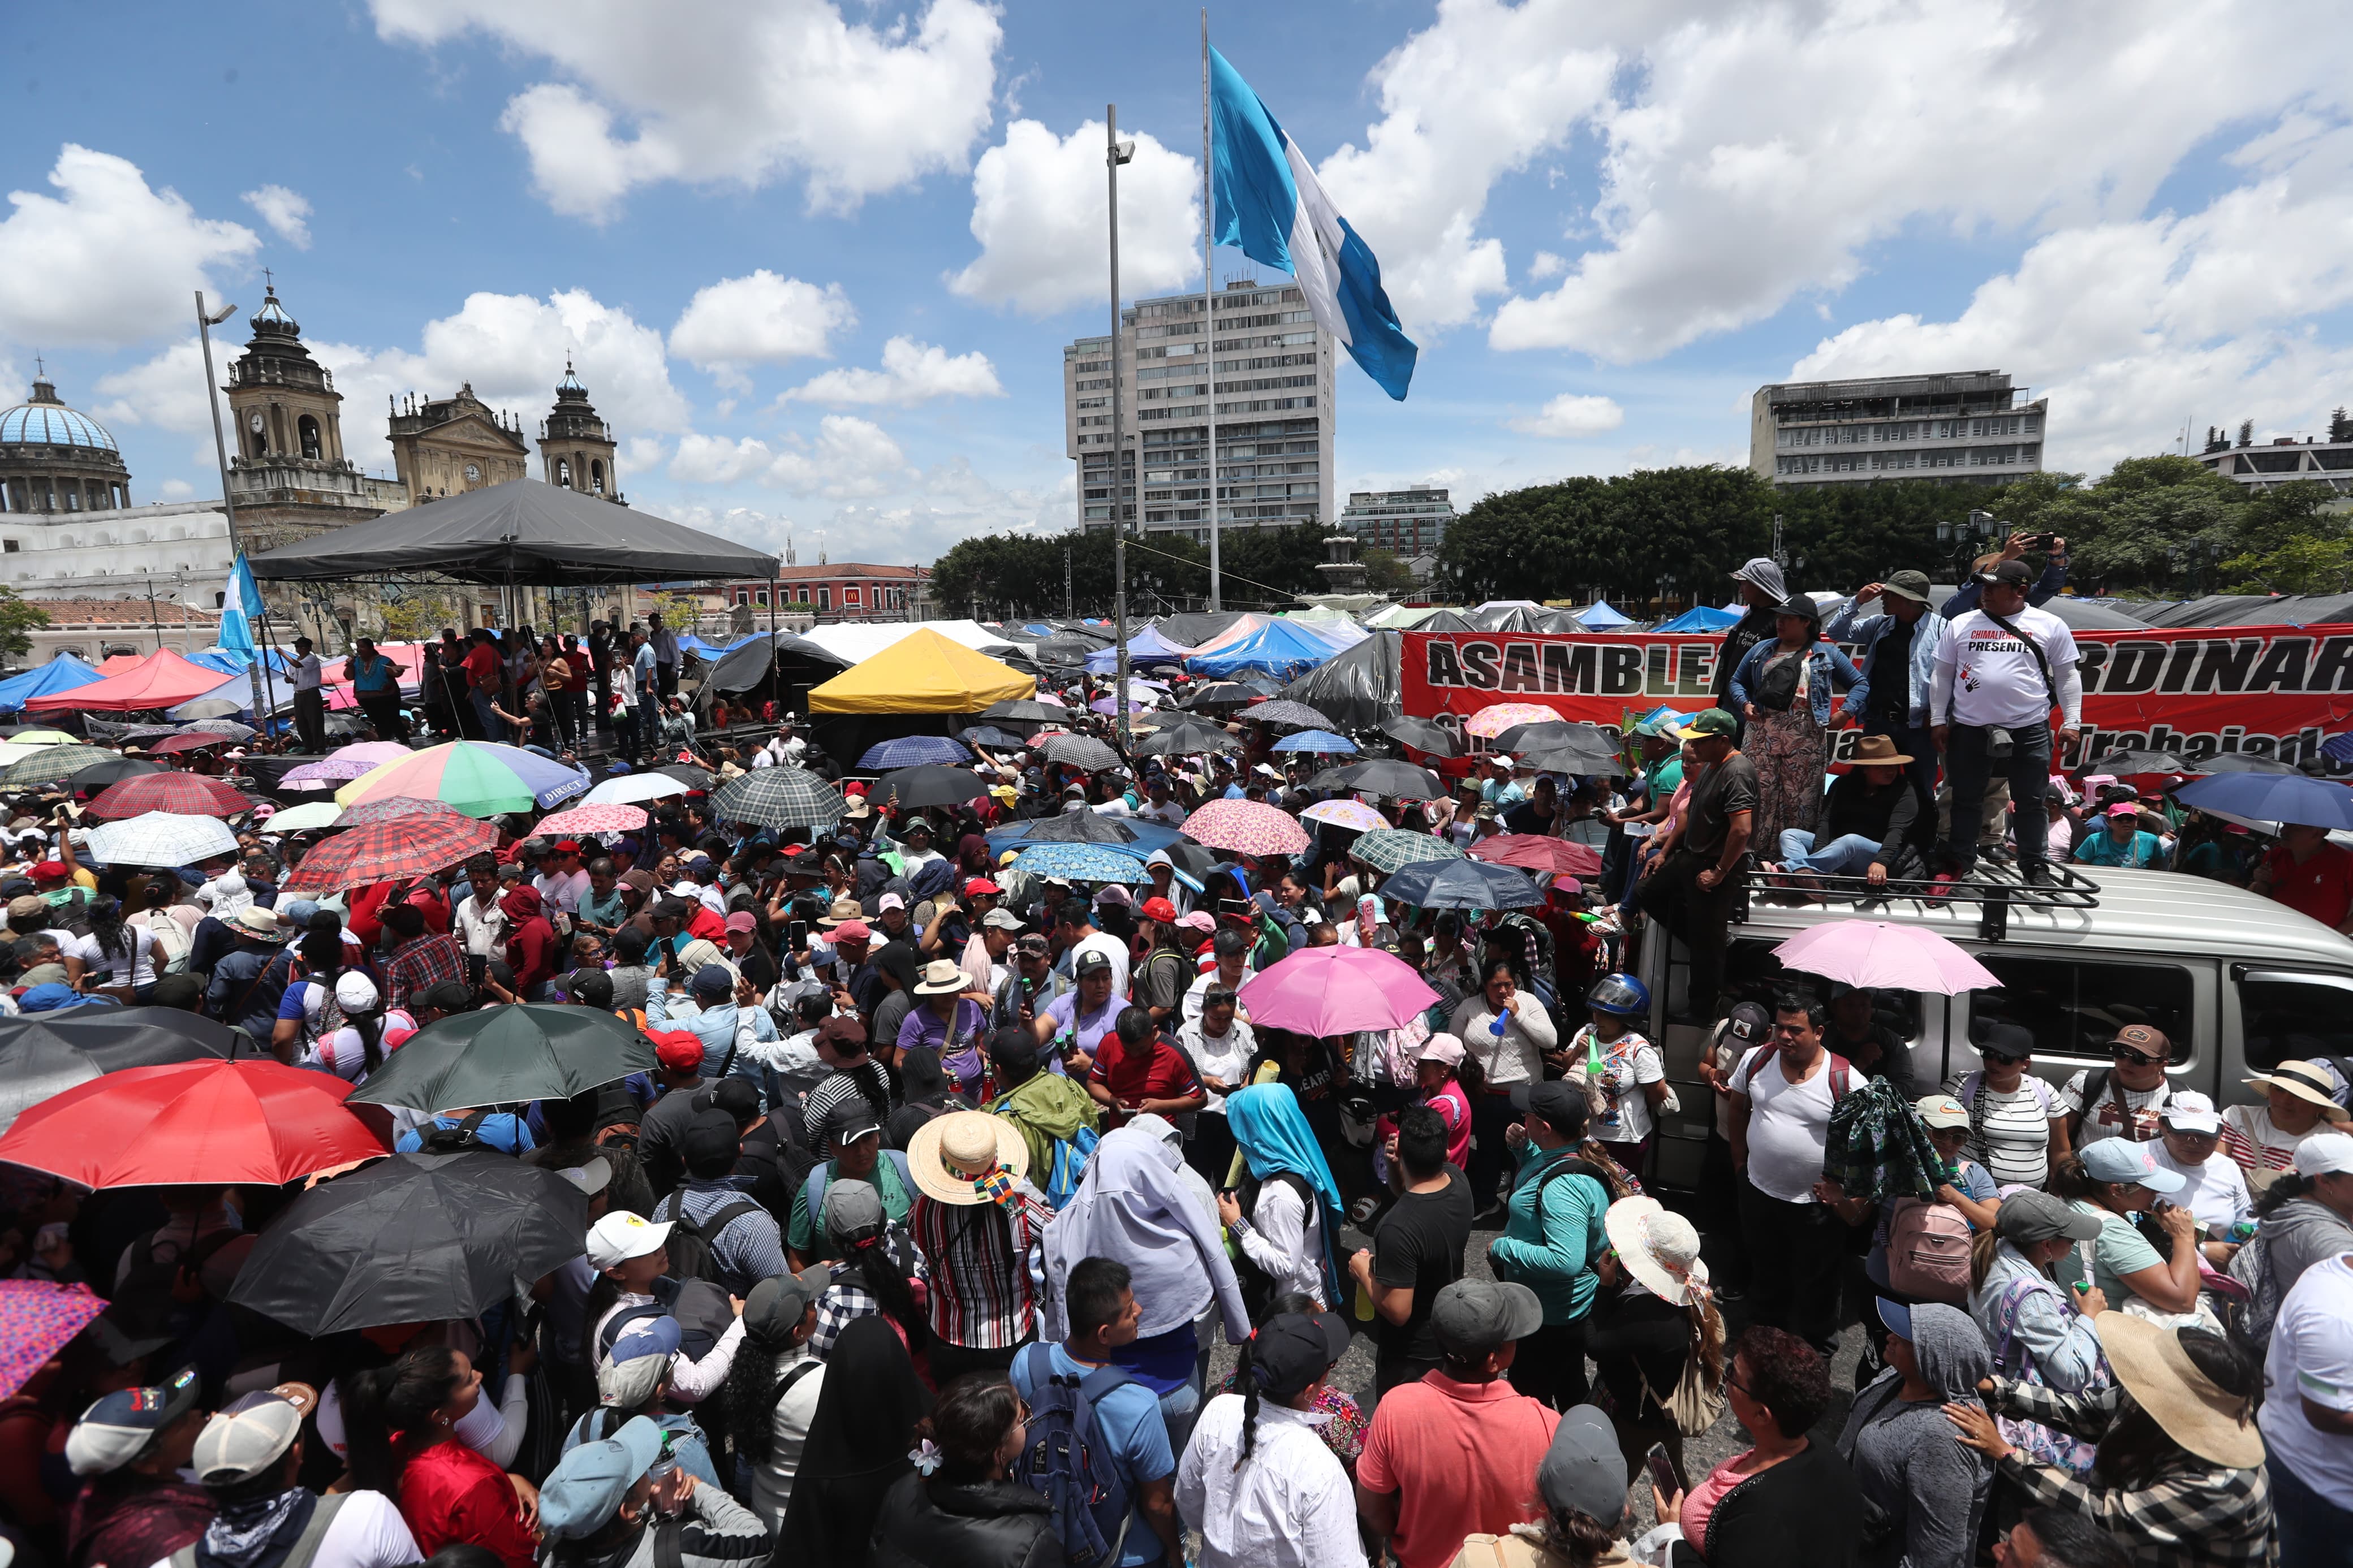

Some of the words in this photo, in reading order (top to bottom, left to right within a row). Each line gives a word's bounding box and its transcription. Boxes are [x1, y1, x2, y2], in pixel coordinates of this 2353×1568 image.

[1968, 641, 2029, 654] PRESENTE
[2076, 635, 2353, 695] RDINAR
[544, 780, 582, 802] DIRECT
[1299, 1069, 1331, 1092] EARS
[1945, 1101, 1962, 1111] NIKE
[1974, 1096, 1984, 1121] NICOLE
